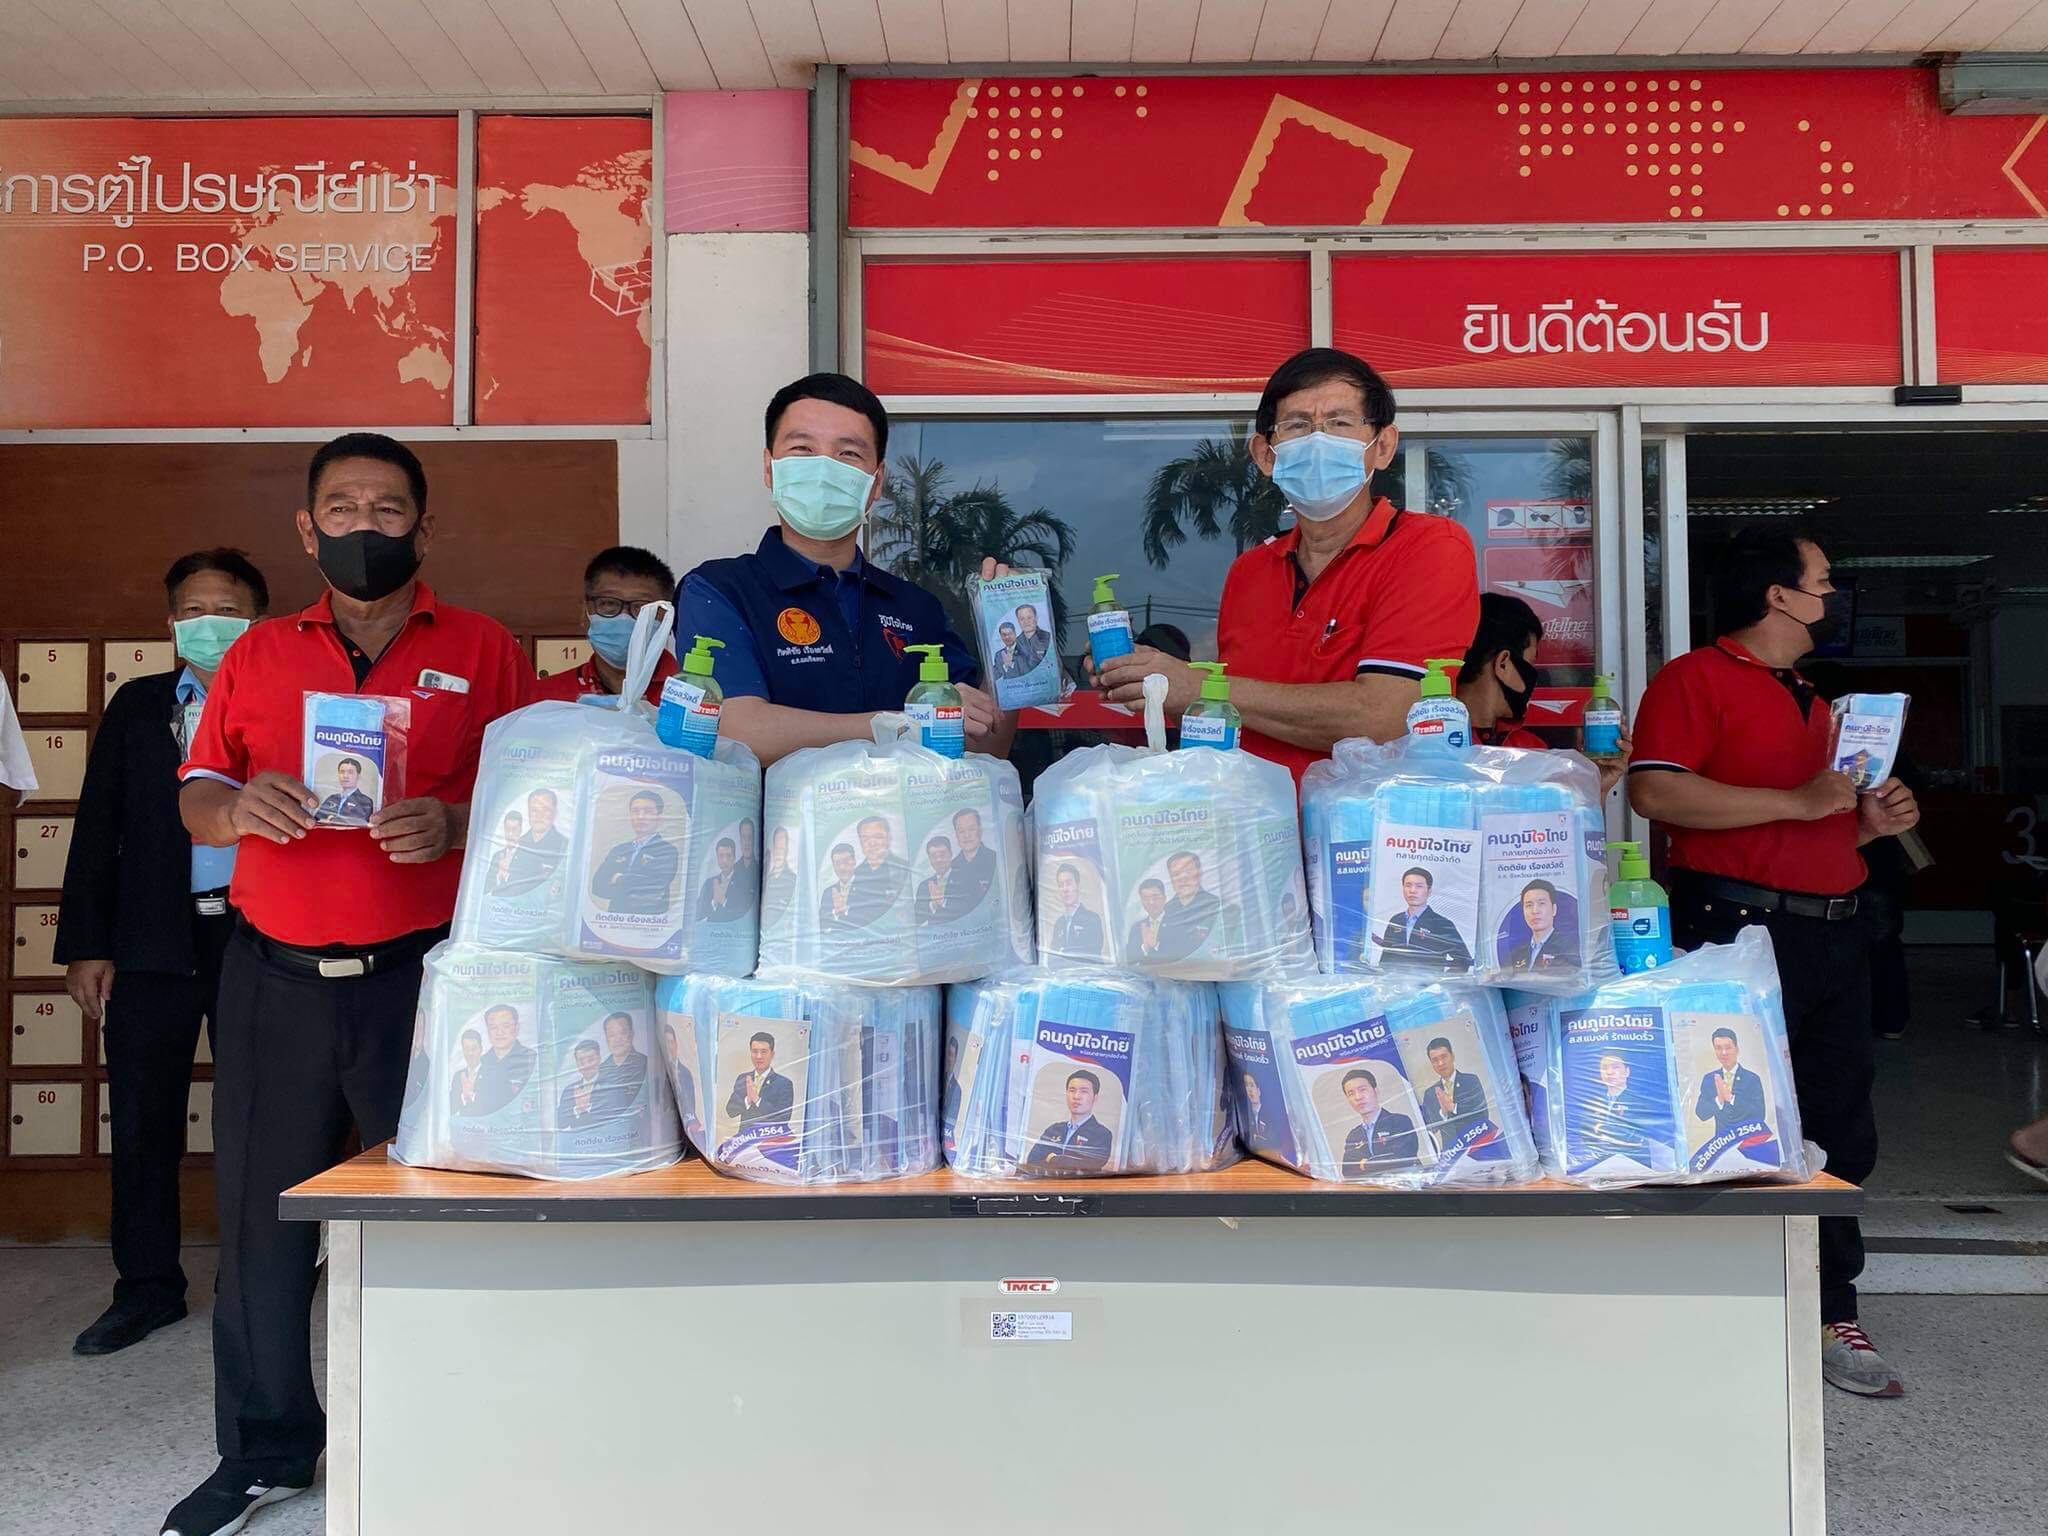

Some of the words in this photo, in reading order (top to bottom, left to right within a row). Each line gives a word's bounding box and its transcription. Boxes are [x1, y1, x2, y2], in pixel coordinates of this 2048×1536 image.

[0, 156, 437, 228] การตู้ไปรษณีย์เช่า
[82, 244, 154, 272] P.O.
[176, 244, 255, 272] BOX
[275, 243, 432, 273] SERVICE
[1462, 299, 1769, 353] ยินดีต้อนรับ
[48, 649, 57, 662] 5
[134, 649, 143, 662] 6
[562, 647, 577, 660] 11
[45, 736, 63, 749] 16
[316, 731, 382, 746] คนภูมิใจไทย
[1121, 808, 1208, 828] คนภูมิใจไทย
[41, 825, 59, 839] 27
[1487, 828, 1568, 849] คนภูมิใจไทย
[1386, 836, 1472, 854] คนภูมิใจไทย
[40, 913, 58, 927] 38
[36, 1003, 54, 1016] 49
[1567, 1014, 1654, 1032] คนภูมิใจไทย
[1039, 1029, 1130, 1052] คนภูมิใจไทย
[1296, 1024, 1386, 1060] คนภูมิใจไทย
[38, 1090, 56, 1104] 60
[758, 1126, 784, 1137] 2564
[1464, 1122, 1489, 1143] 2564
[1737, 1122, 1762, 1137] 2564
[1003, 1280, 1054, 1292] TMCL
